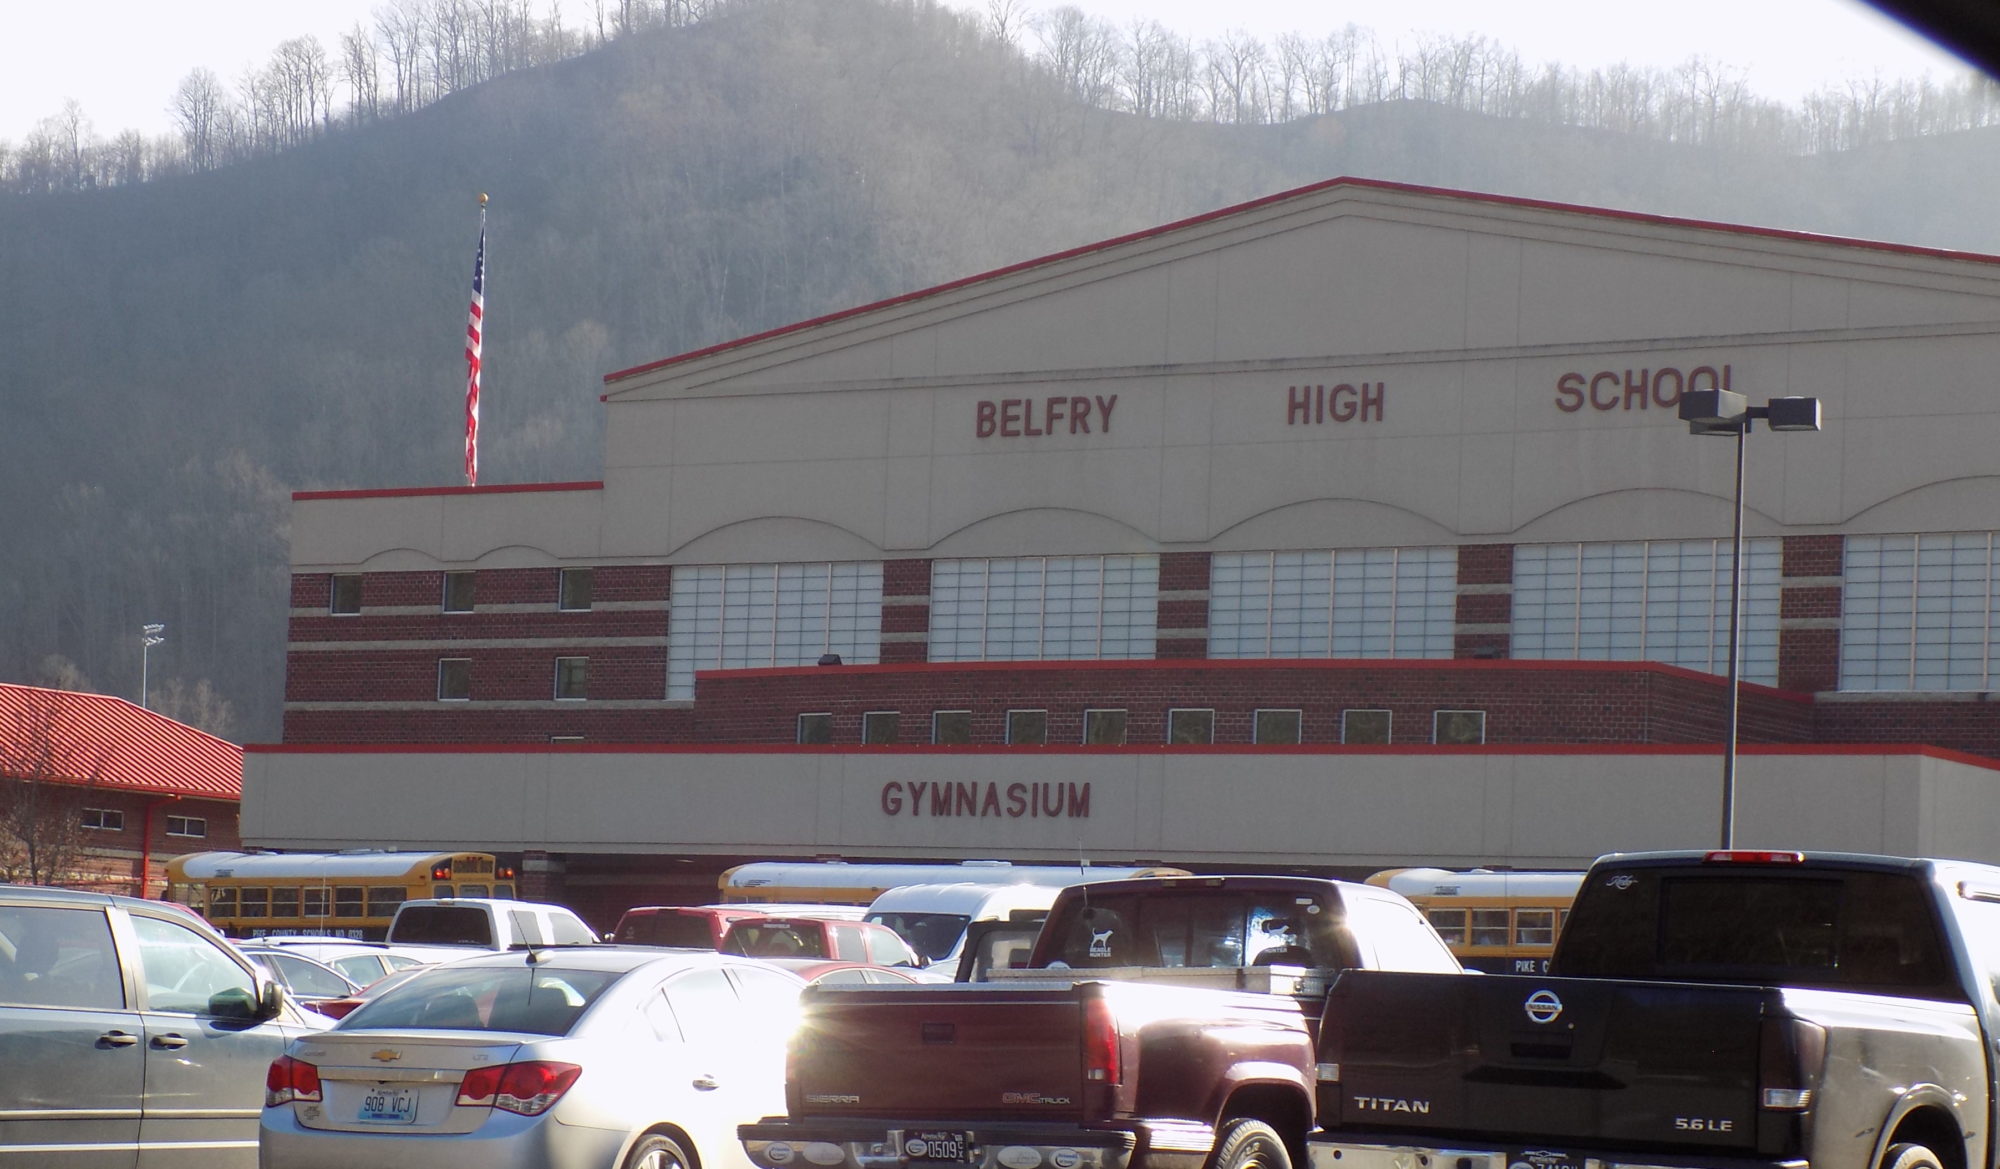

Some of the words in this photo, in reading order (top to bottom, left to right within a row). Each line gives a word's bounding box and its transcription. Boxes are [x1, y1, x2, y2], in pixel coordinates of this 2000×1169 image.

[976, 394, 1118, 438] BELFRY
[1287, 382, 1385, 425] HIGH
[881, 781, 1091, 818] GYMNASIUM
[1515, 960, 1536, 973] PIKE
[364, 1096, 385, 1112] 908
[392, 1097, 411, 1113] VCJ
[806, 1095, 860, 1104] SIERRA
[1002, 1092, 1040, 1104] GMC
[1354, 1096, 1430, 1113] TITAN
[1675, 1118, 1704, 1130] 5.6
[1708, 1120, 1733, 1132] LE
[928, 1141, 957, 1158] 0509
